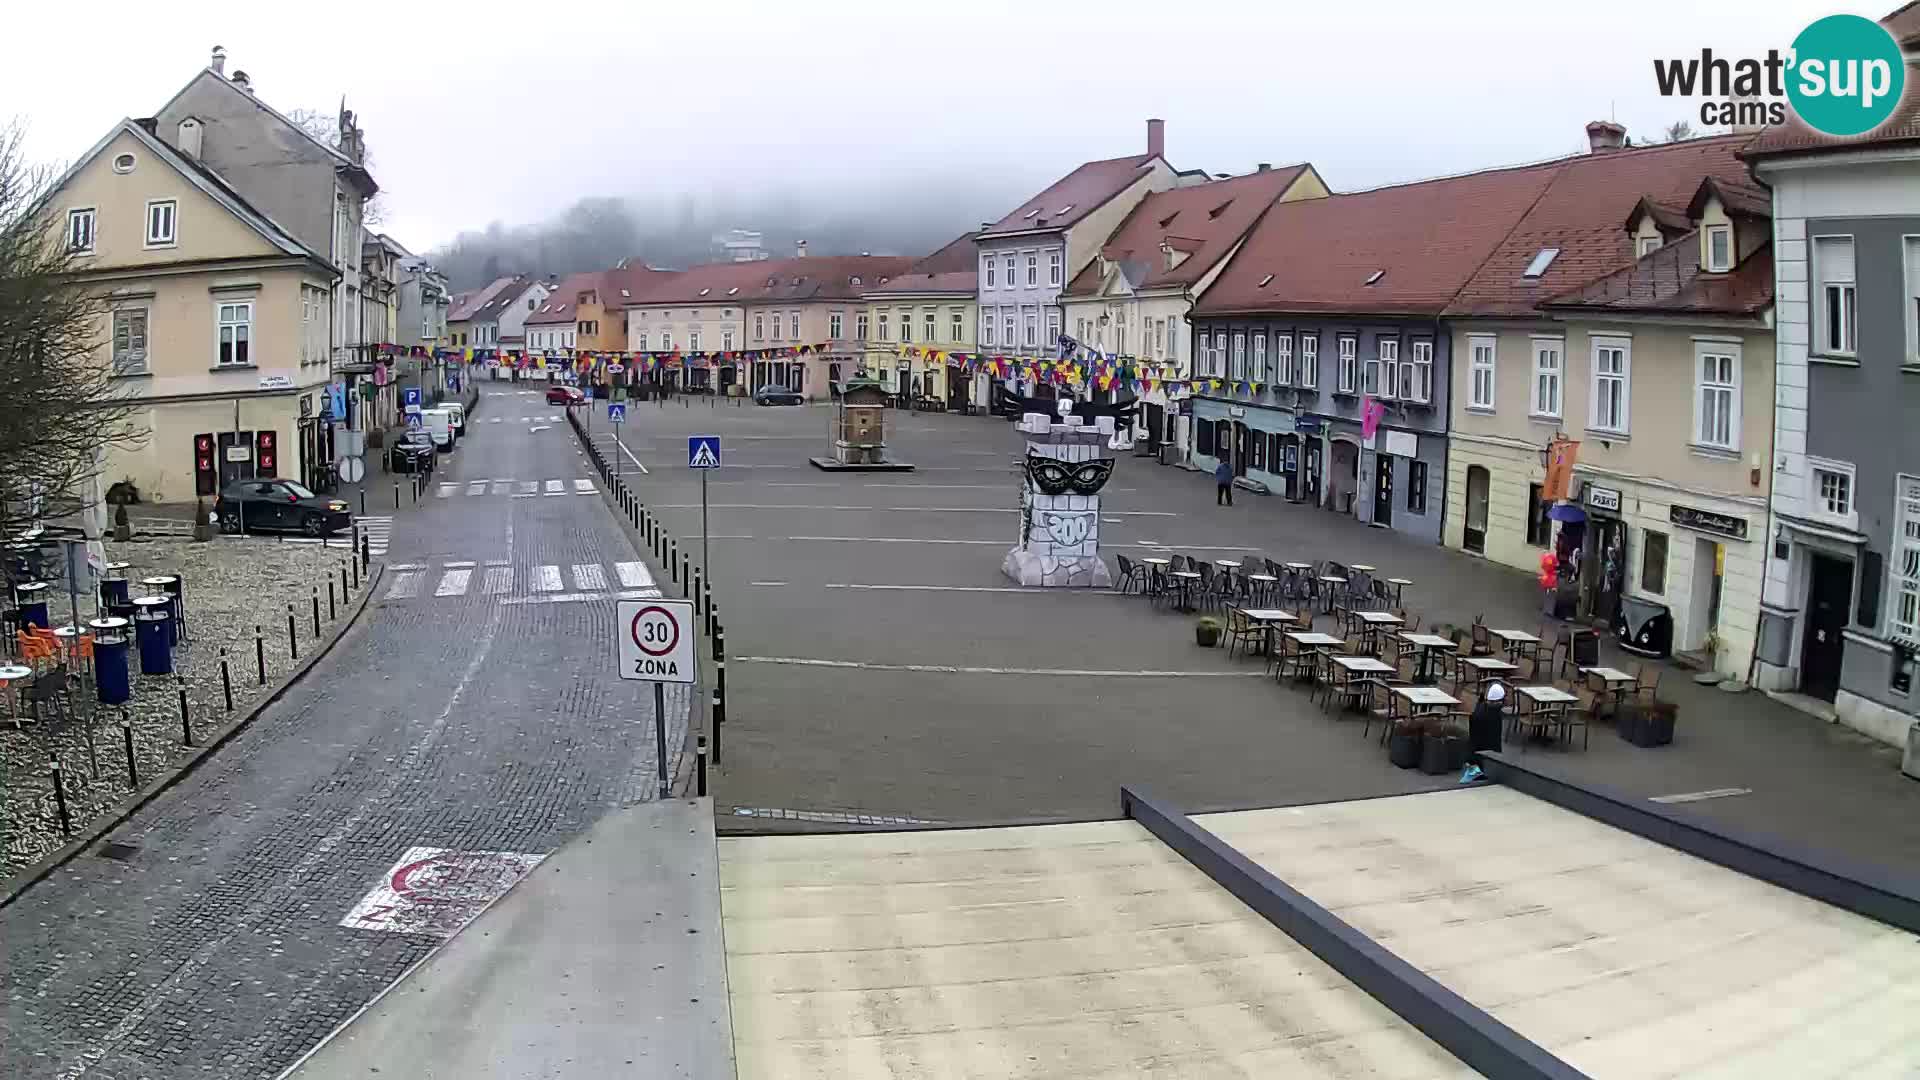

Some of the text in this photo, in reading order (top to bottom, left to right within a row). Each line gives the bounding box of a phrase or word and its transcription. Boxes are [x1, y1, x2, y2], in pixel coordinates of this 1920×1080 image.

[409, 391, 417, 403] P
[644, 622, 668, 643] 30
[634, 659, 678, 675] ZONA
